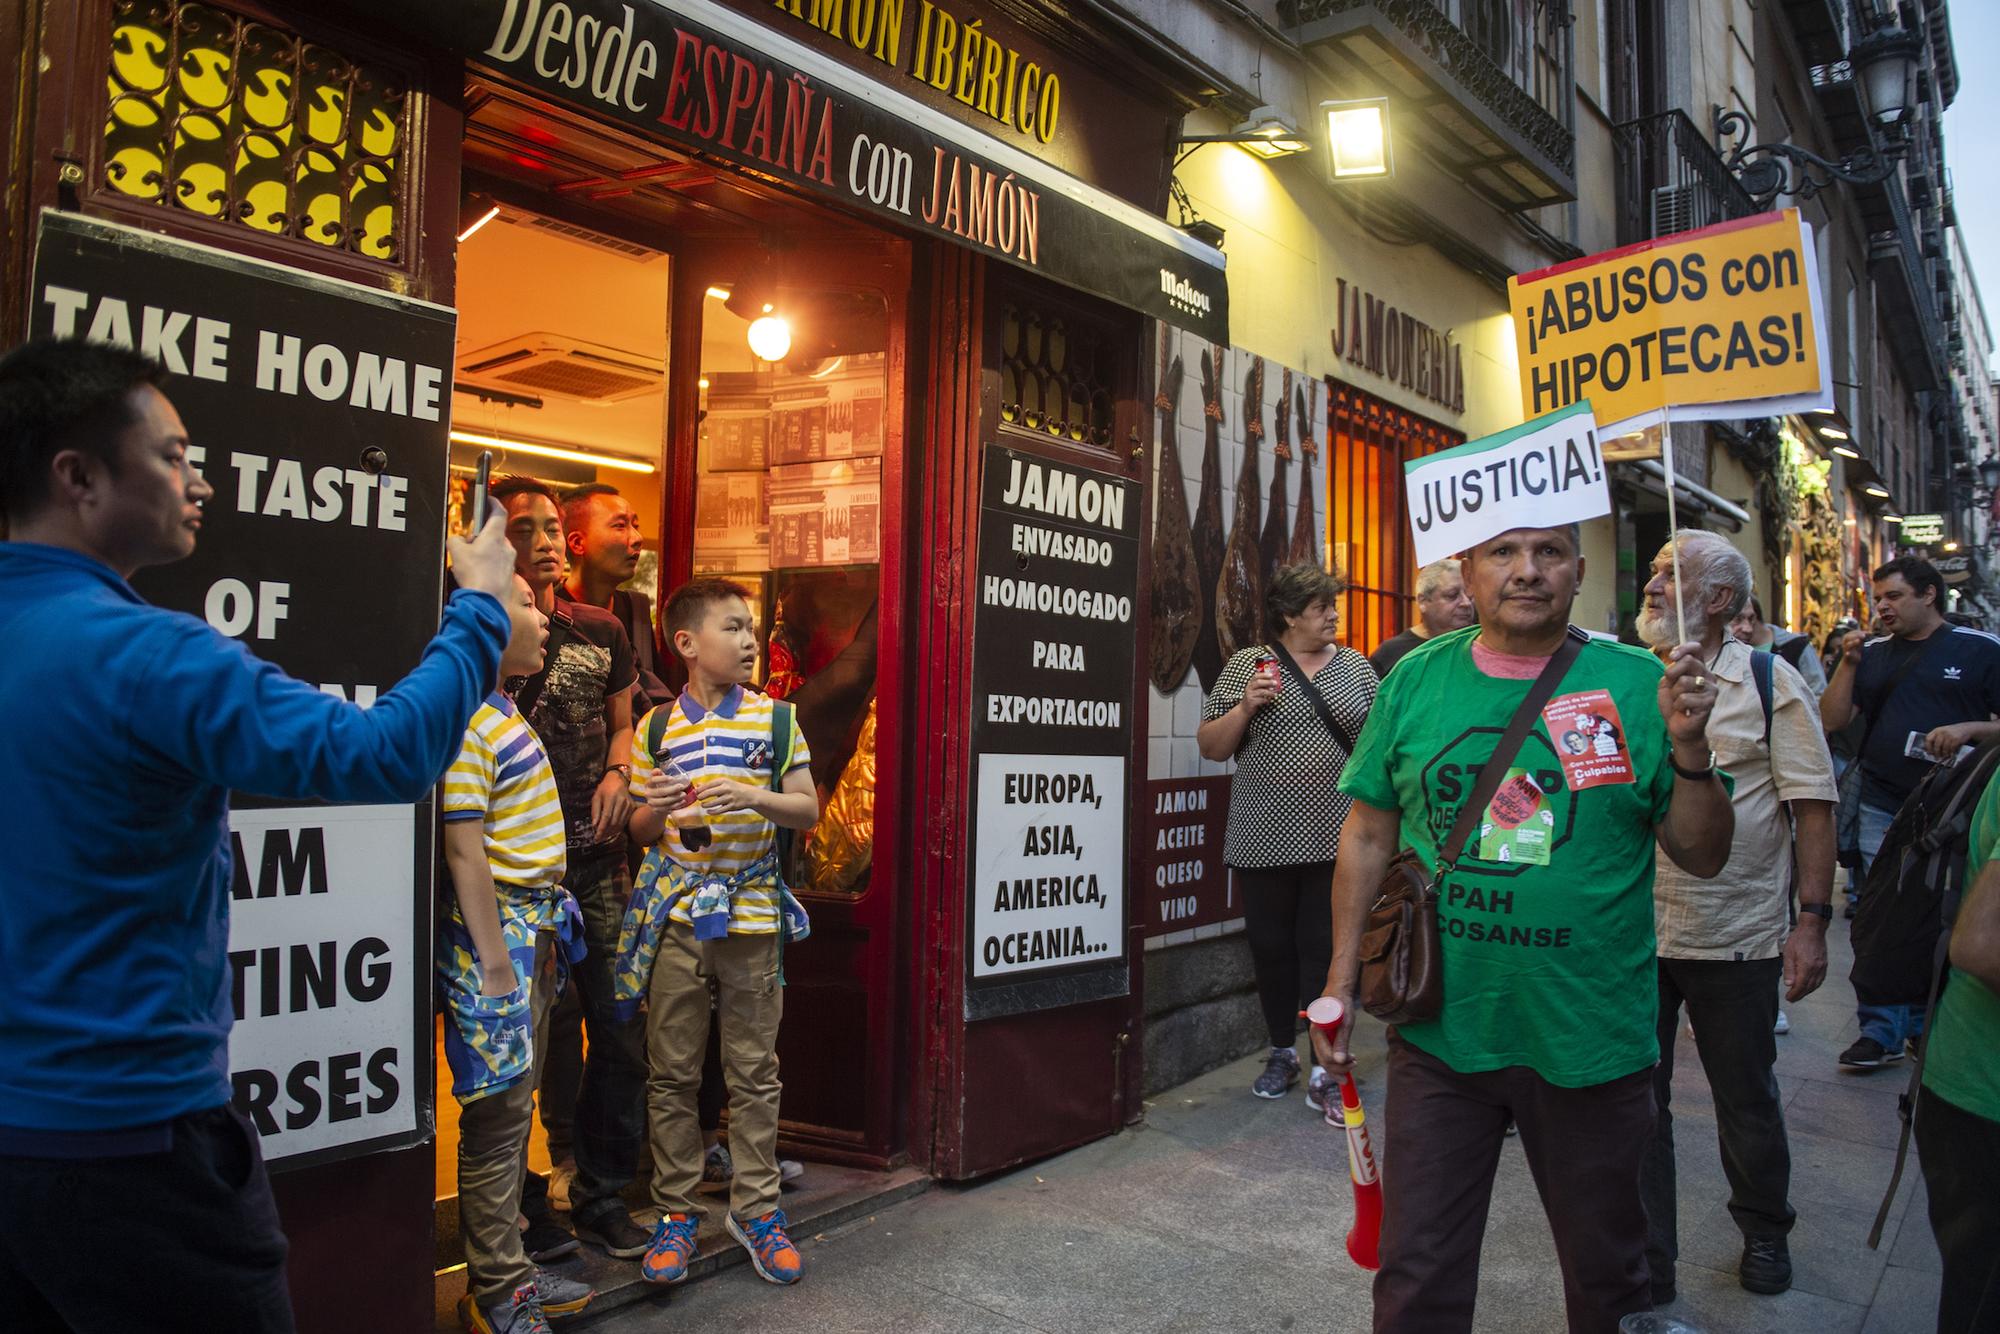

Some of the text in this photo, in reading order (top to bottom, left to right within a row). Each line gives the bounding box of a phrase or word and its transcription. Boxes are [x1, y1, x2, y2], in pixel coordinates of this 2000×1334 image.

[912, 0, 1060, 144] IBÉRICO
[483, 0, 1040, 265] Desde ESPAÑA con JAMÓN
[1160, 268, 1211, 312] Mahou
[1527, 247, 1800, 355] ¡ABUSOS con
[43, 284, 443, 423] TAKE HOME
[1331, 277, 1466, 415] JAMONERÍA
[1531, 311, 1807, 415] HIPOTECAS!
[231, 452, 409, 532] TASTE
[1003, 459, 1125, 530] JAMON
[1415, 429, 1602, 533] JUSTICIA!
[1012, 524, 1113, 567] ENVASADO
[204, 578, 291, 640] OF
[984, 575, 1131, 623] HOMOLOGADO
[1033, 640, 1086, 672] PARA
[987, 694, 1121, 728] EXPORTACION
[1004, 774, 1103, 810] EUROPA,
[1436, 763, 1563, 802] STP
[1574, 764, 1627, 779] Culpables
[1155, 789, 1208, 815] JAMON
[1023, 825, 1083, 861] ASIA,
[1156, 824, 1205, 851] ACEITE
[994, 874, 1107, 912] AMERICA,
[1156, 859, 1204, 888] QUESO
[1160, 895, 1198, 923] VINO
[1447, 883, 1514, 915] PAH
[984, 926, 1108, 967] OCEANIA...
